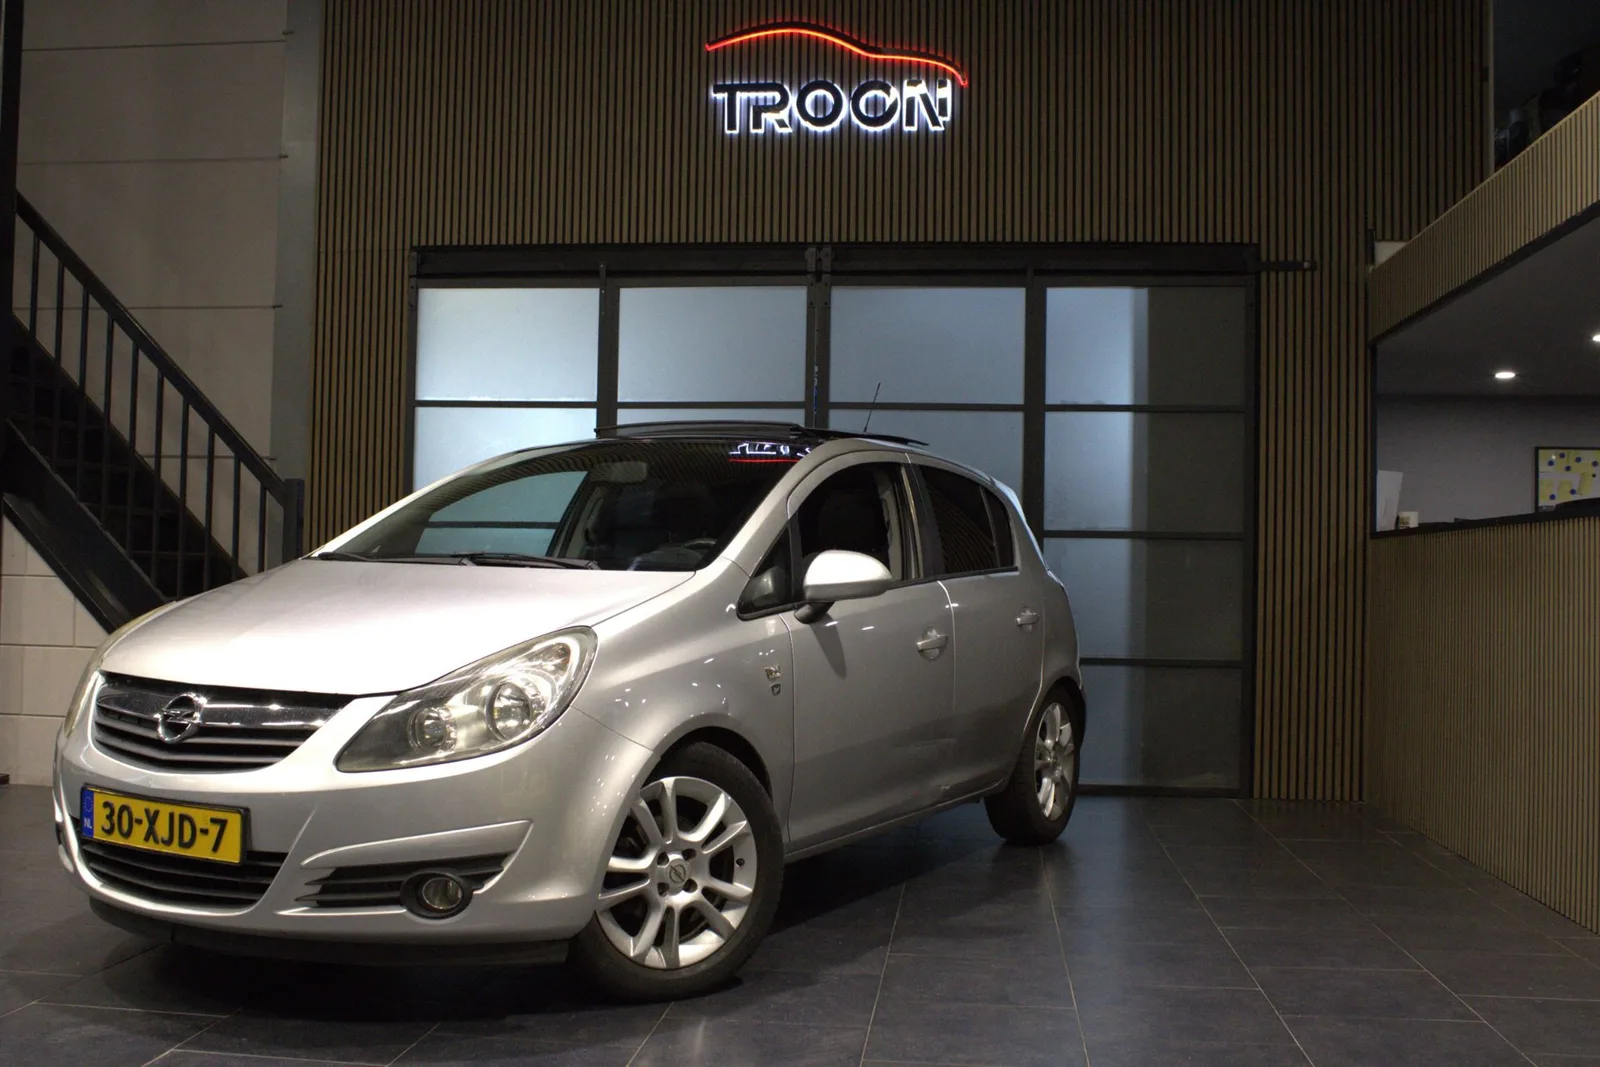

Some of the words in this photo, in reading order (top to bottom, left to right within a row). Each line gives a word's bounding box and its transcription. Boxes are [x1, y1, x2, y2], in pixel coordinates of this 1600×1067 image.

[712, 79, 950, 133] TROON
[83, 817, 93, 829] NL
[101, 801, 228, 854] 30-XJD-7
